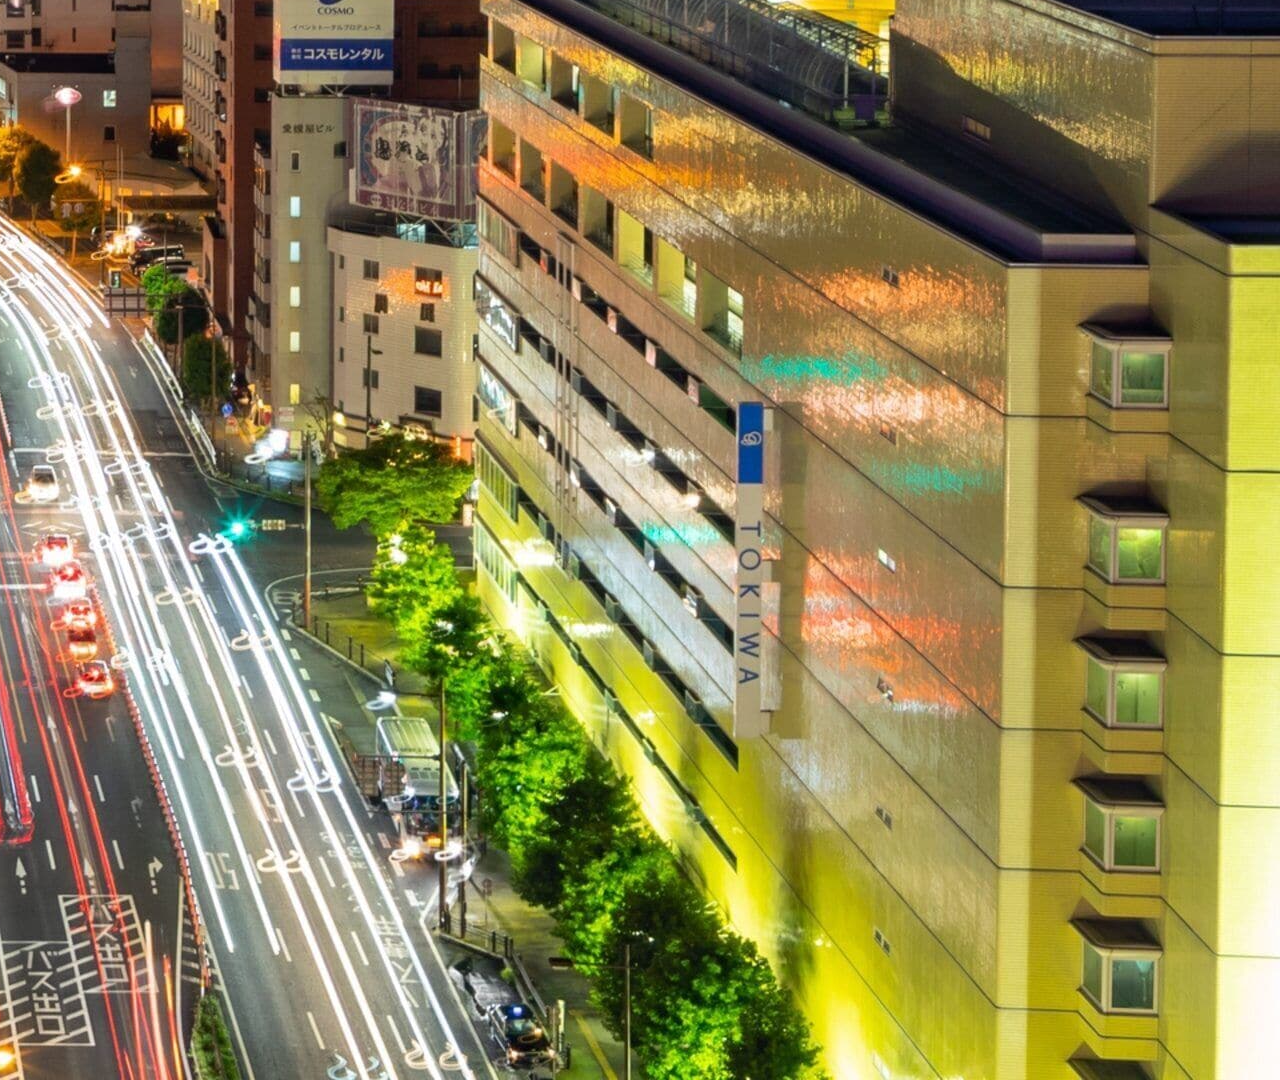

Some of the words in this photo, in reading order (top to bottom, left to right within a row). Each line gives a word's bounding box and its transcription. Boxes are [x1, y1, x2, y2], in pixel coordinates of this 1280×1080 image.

[317, 7, 354, 15] COSMO
[303, 47, 384, 61] コスモレンタル
[738, 521, 761, 684] TOKIWA
[26, 950, 67, 1035] バス出口
